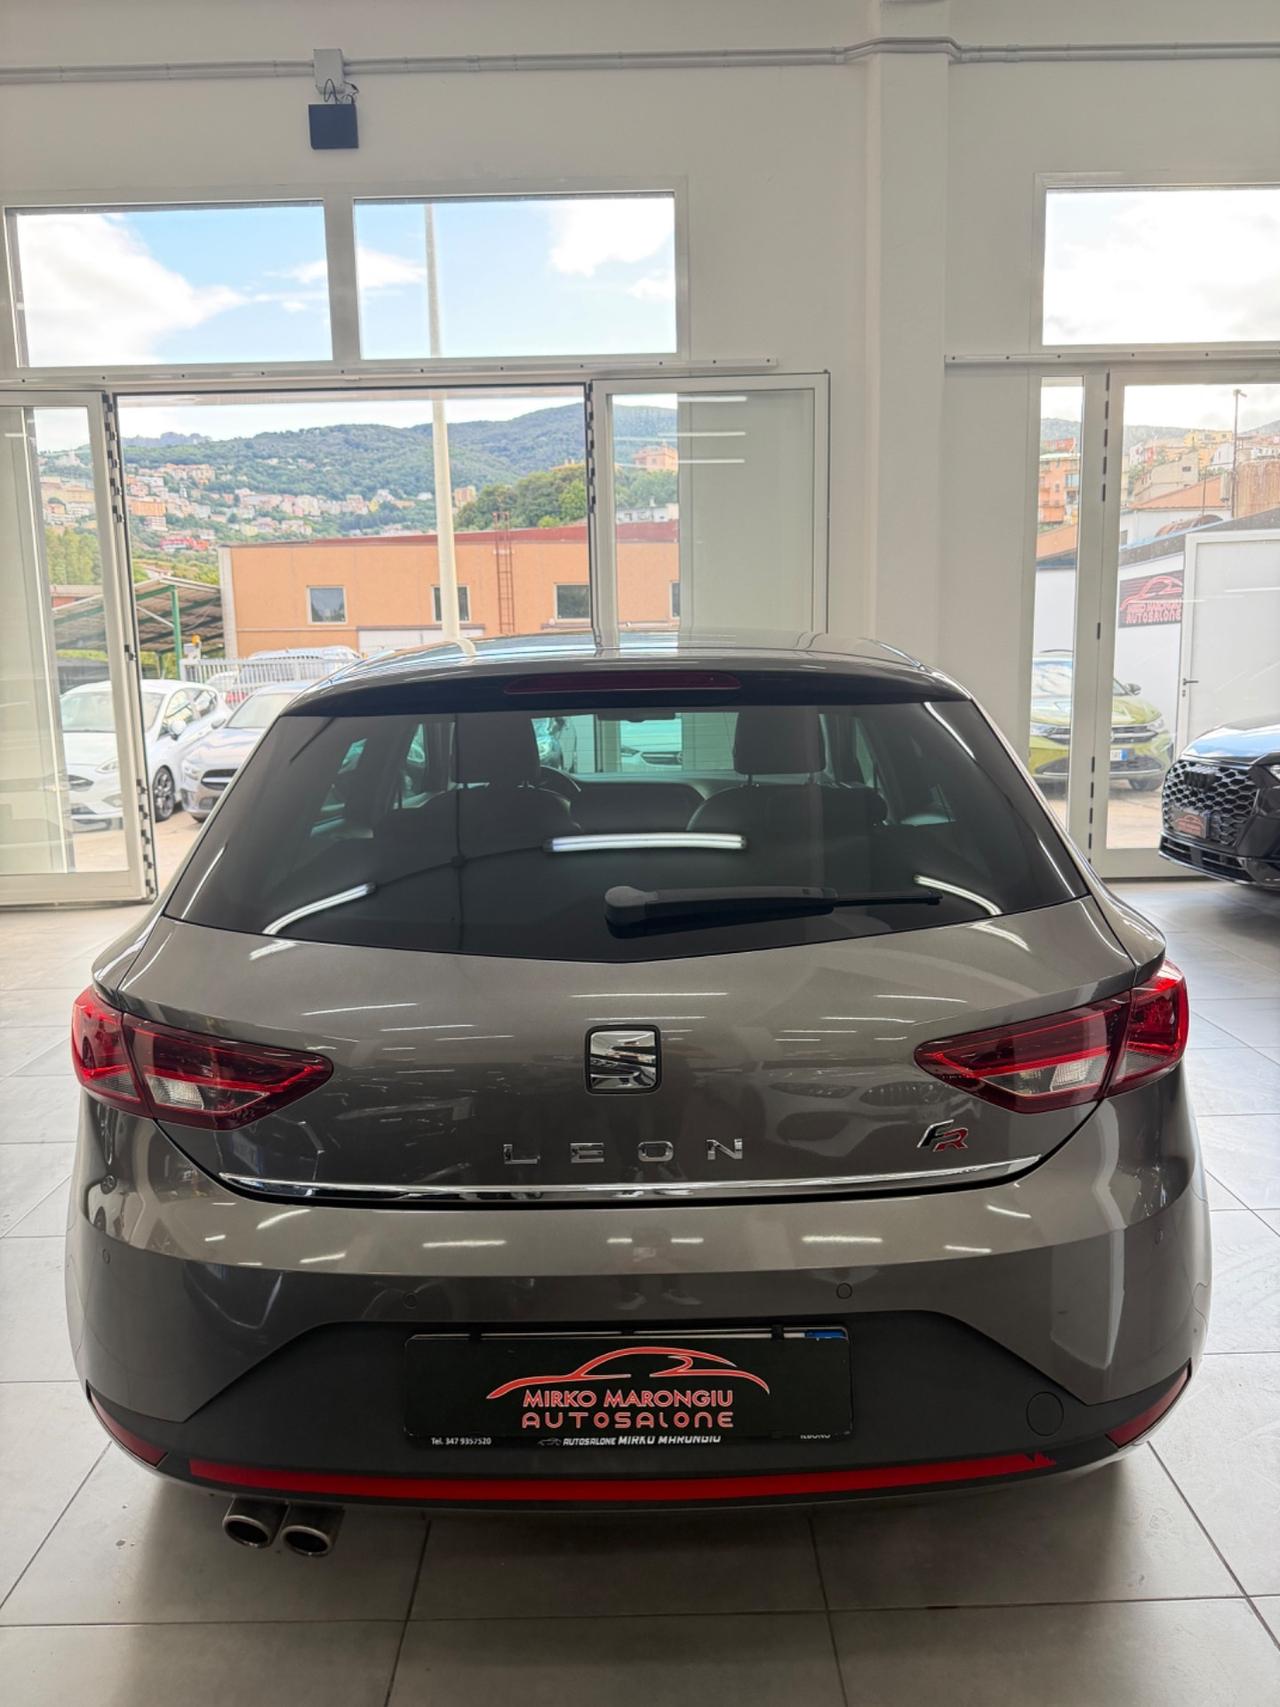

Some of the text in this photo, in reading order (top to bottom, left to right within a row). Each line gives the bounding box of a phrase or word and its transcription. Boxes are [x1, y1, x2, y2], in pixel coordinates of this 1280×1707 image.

[916, 1119, 969, 1152] FR
[503, 1138, 743, 1165] LEON
[522, 1389, 733, 1408] MIRKO MARONGIU
[521, 1411, 734, 1429] AUTOSALONE
[563, 1437, 616, 1446] AUTOSALONE
